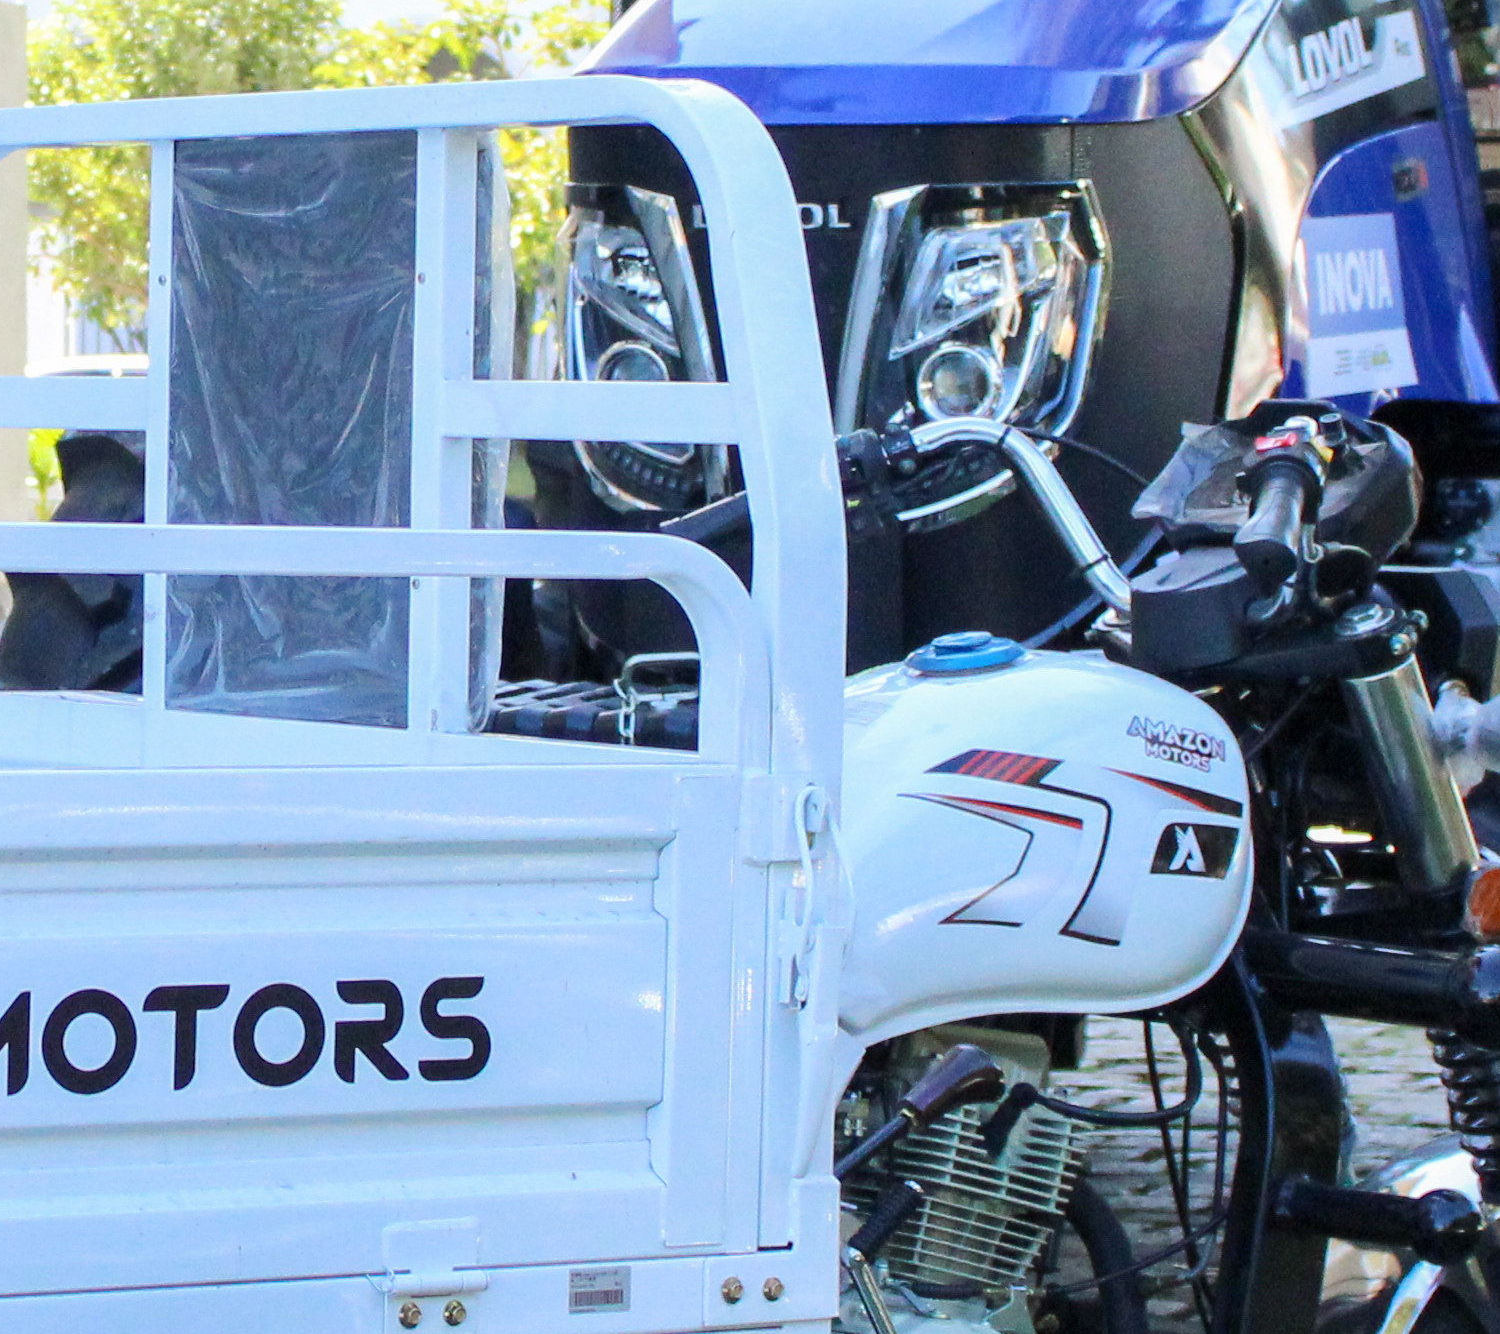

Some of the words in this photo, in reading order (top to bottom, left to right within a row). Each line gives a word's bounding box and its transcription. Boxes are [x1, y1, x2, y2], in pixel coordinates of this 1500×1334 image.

[1288, 16, 1374, 99] LOVOL
[1316, 248, 1395, 316] INOVA
[1126, 715, 1226, 762] AMAZON
[1145, 742, 1211, 773] MOTORS
